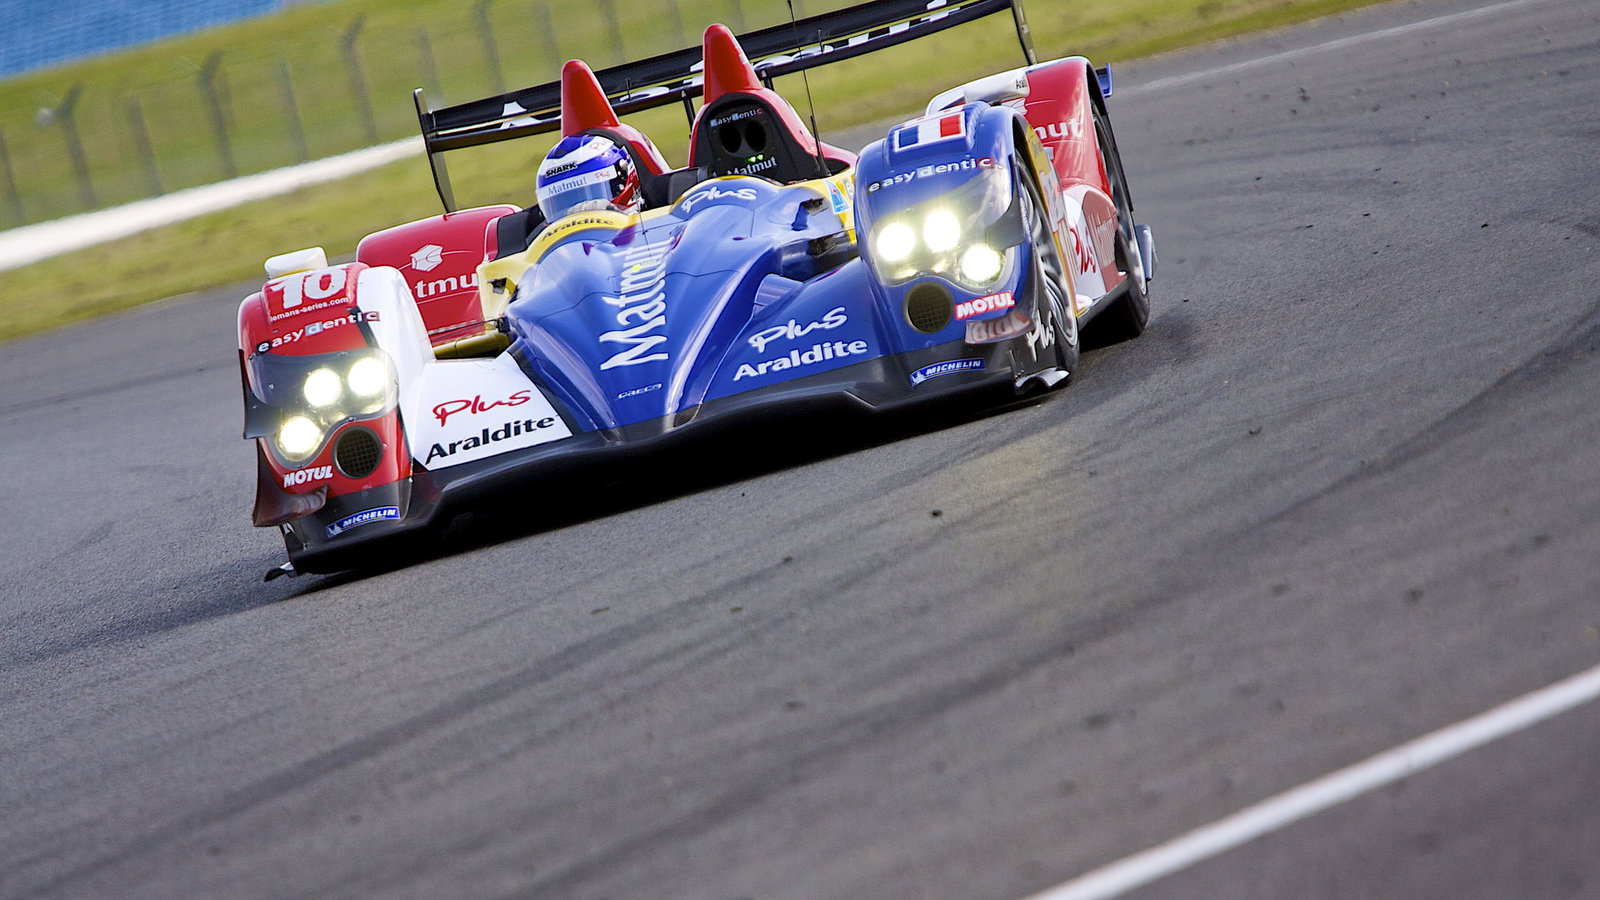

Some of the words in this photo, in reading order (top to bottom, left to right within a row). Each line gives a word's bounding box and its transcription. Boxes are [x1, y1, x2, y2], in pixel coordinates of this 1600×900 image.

[545, 162, 578, 178] SHARK
[868, 157, 993, 193] easydentic
[548, 177, 588, 196] Matmut
[681, 186, 757, 213] Plus
[542, 218, 614, 241] Araldite
[269, 268, 347, 309] 10
[956, 292, 1015, 319] MOTUL
[257, 311, 379, 353] easydentic
[748, 306, 848, 353] Plus
[733, 340, 868, 382] Araldite
[926, 360, 981, 376] MICHELIN
[432, 389, 531, 427] Plus
[425, 415, 556, 465] Araldite
[283, 465, 334, 489] MOTUL
[342, 509, 396, 527] MICHELIN
